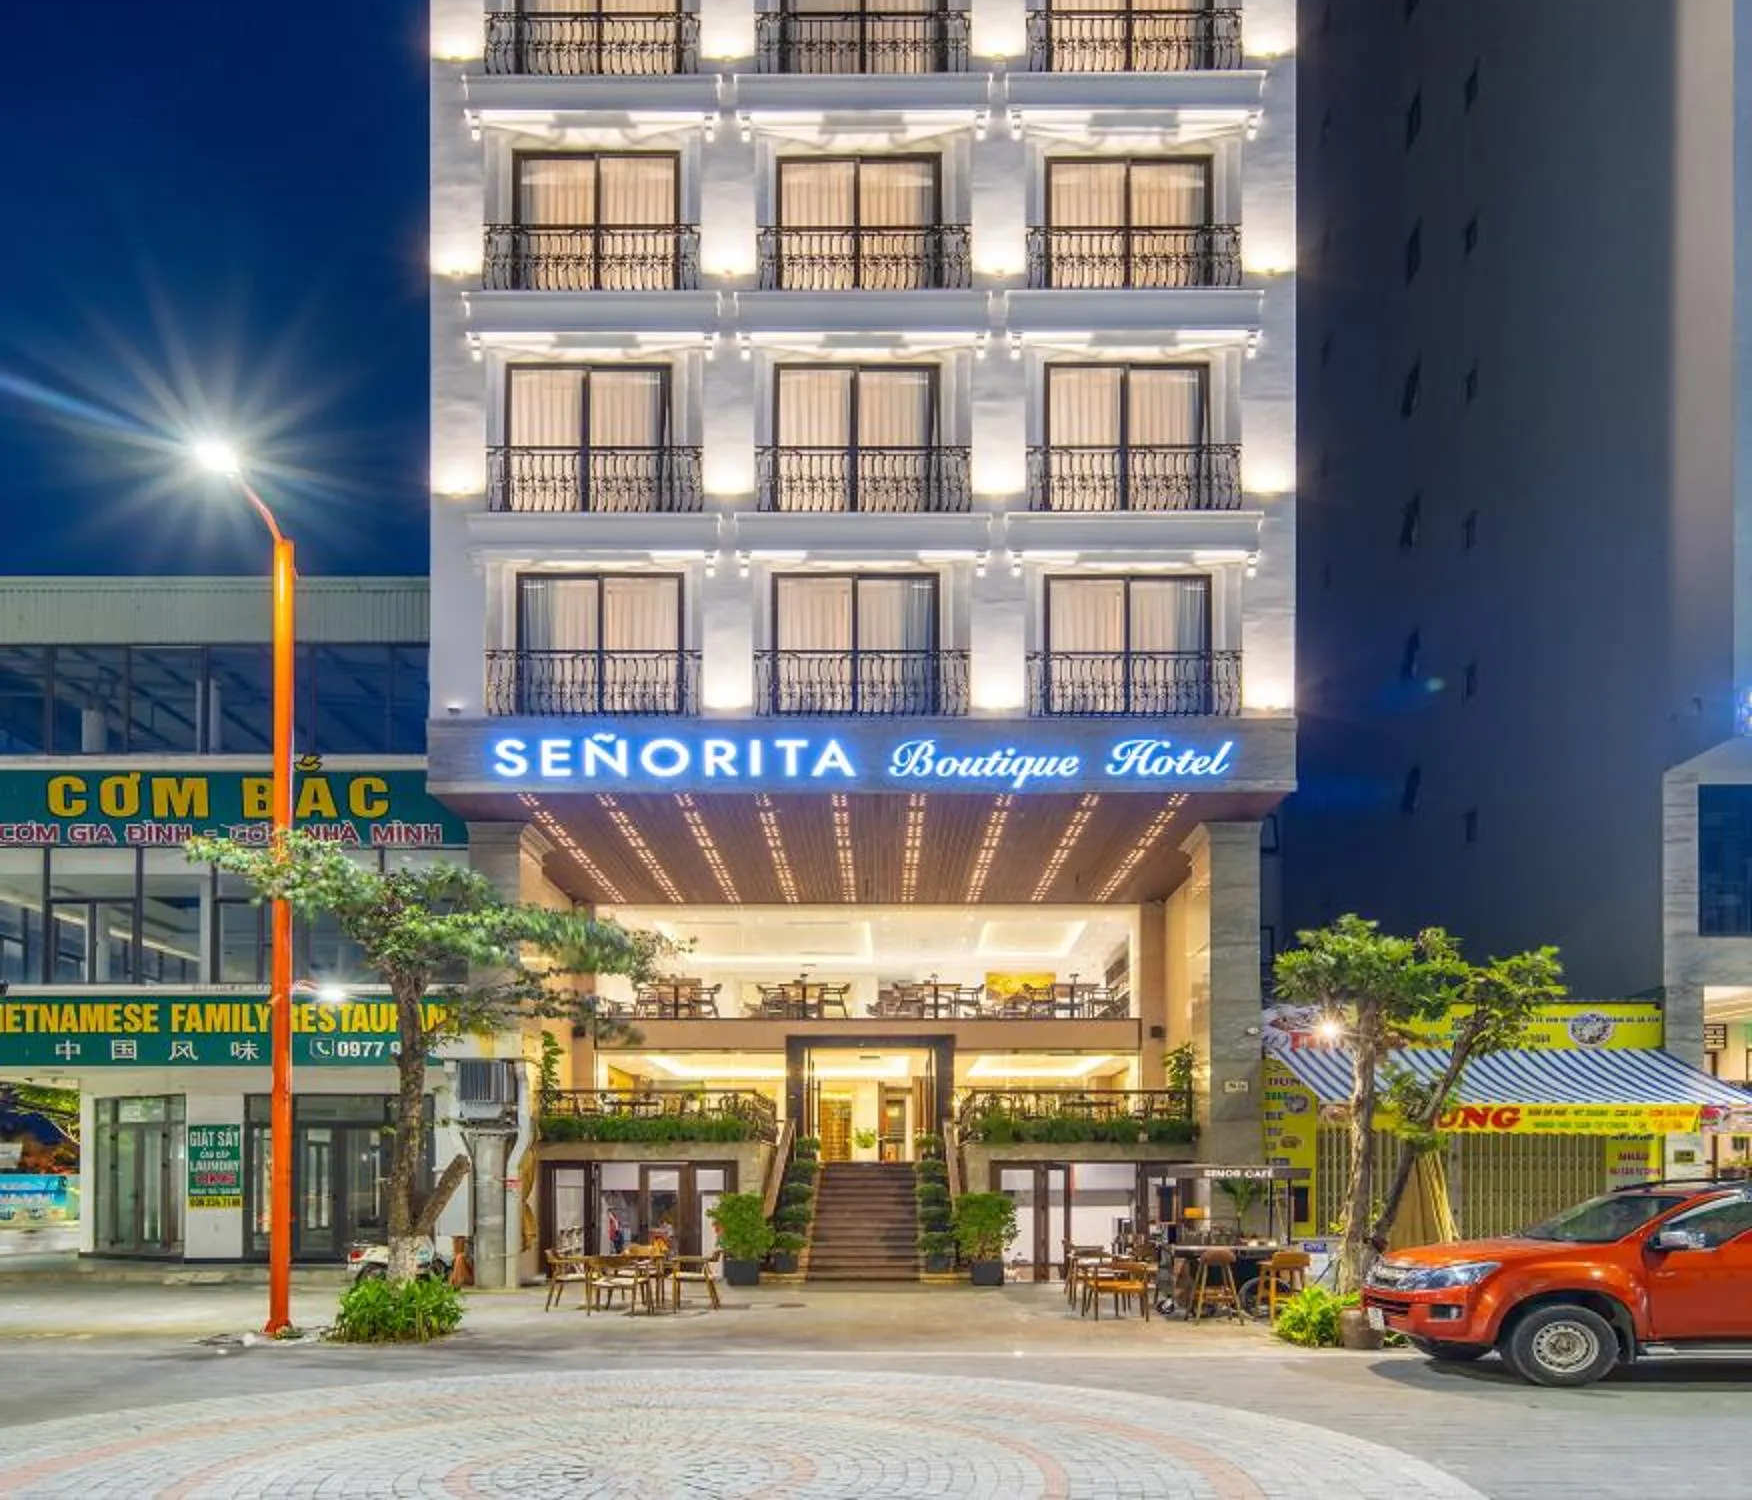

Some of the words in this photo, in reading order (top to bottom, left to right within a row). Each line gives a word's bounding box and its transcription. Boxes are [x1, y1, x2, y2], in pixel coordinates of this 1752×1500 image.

[493, 733, 857, 778] SEÑORITA
[889, 739, 1080, 788] Boutique
[1105, 739, 1234, 777] Hotel
[47, 771, 209, 818] CƠM
[68, 823, 118, 845] GIA
[370, 820, 443, 846] MÌNH
[171, 1003, 273, 1033] FAMILY
[55, 1040, 260, 1061] 中国风味
[337, 1041, 385, 1058] 0977
